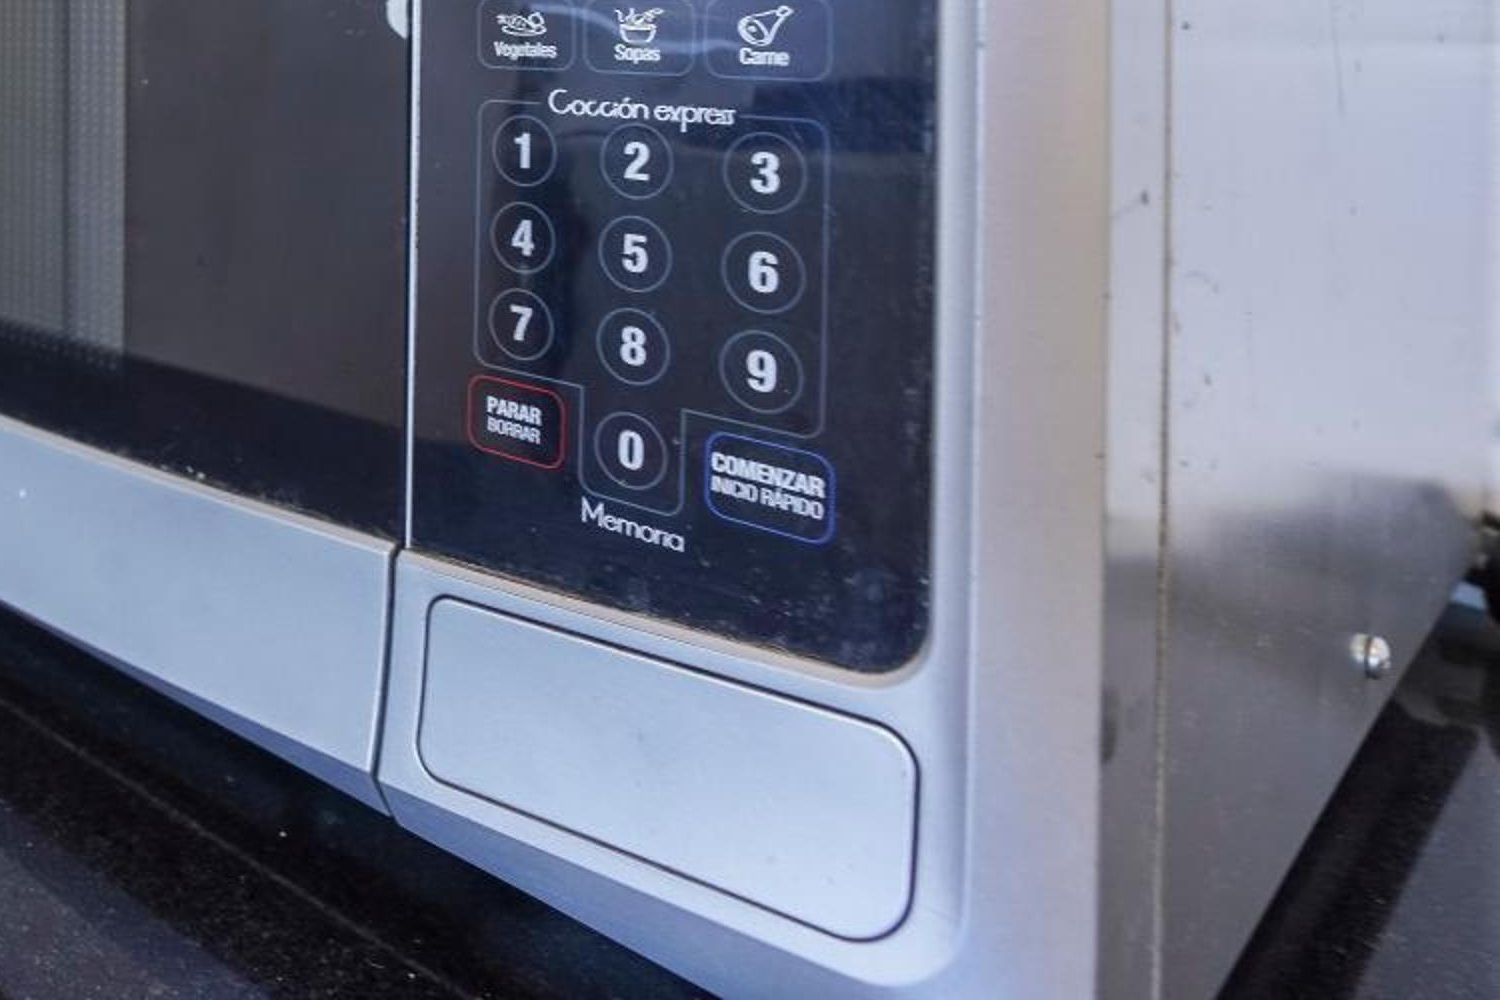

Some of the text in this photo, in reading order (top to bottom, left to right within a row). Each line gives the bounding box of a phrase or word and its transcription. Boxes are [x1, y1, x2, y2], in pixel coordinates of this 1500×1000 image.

[493, 41, 558, 60] Vegetales
[614, 43, 661, 64] Sopas
[739, 48, 790, 66] Carne
[548, 88, 736, 133] Cocción express
[514, 132, 531, 169] 1
[623, 141, 650, 181] 2
[749, 151, 781, 194] 3
[511, 219, 535, 257] 4
[621, 233, 649, 273] 5
[747, 250, 779, 293] 6
[510, 304, 534, 341] 7
[619, 325, 648, 367] 8
[745, 349, 778, 394] 9
[486, 395, 543, 427] PARAR
[486, 417, 542, 446] BORRAR
[617, 429, 645, 472] 0
[711, 451, 826, 500] COMENZAR
[581, 495, 685, 553] Memoria
[760, 487, 825, 521] RÁPIDO
